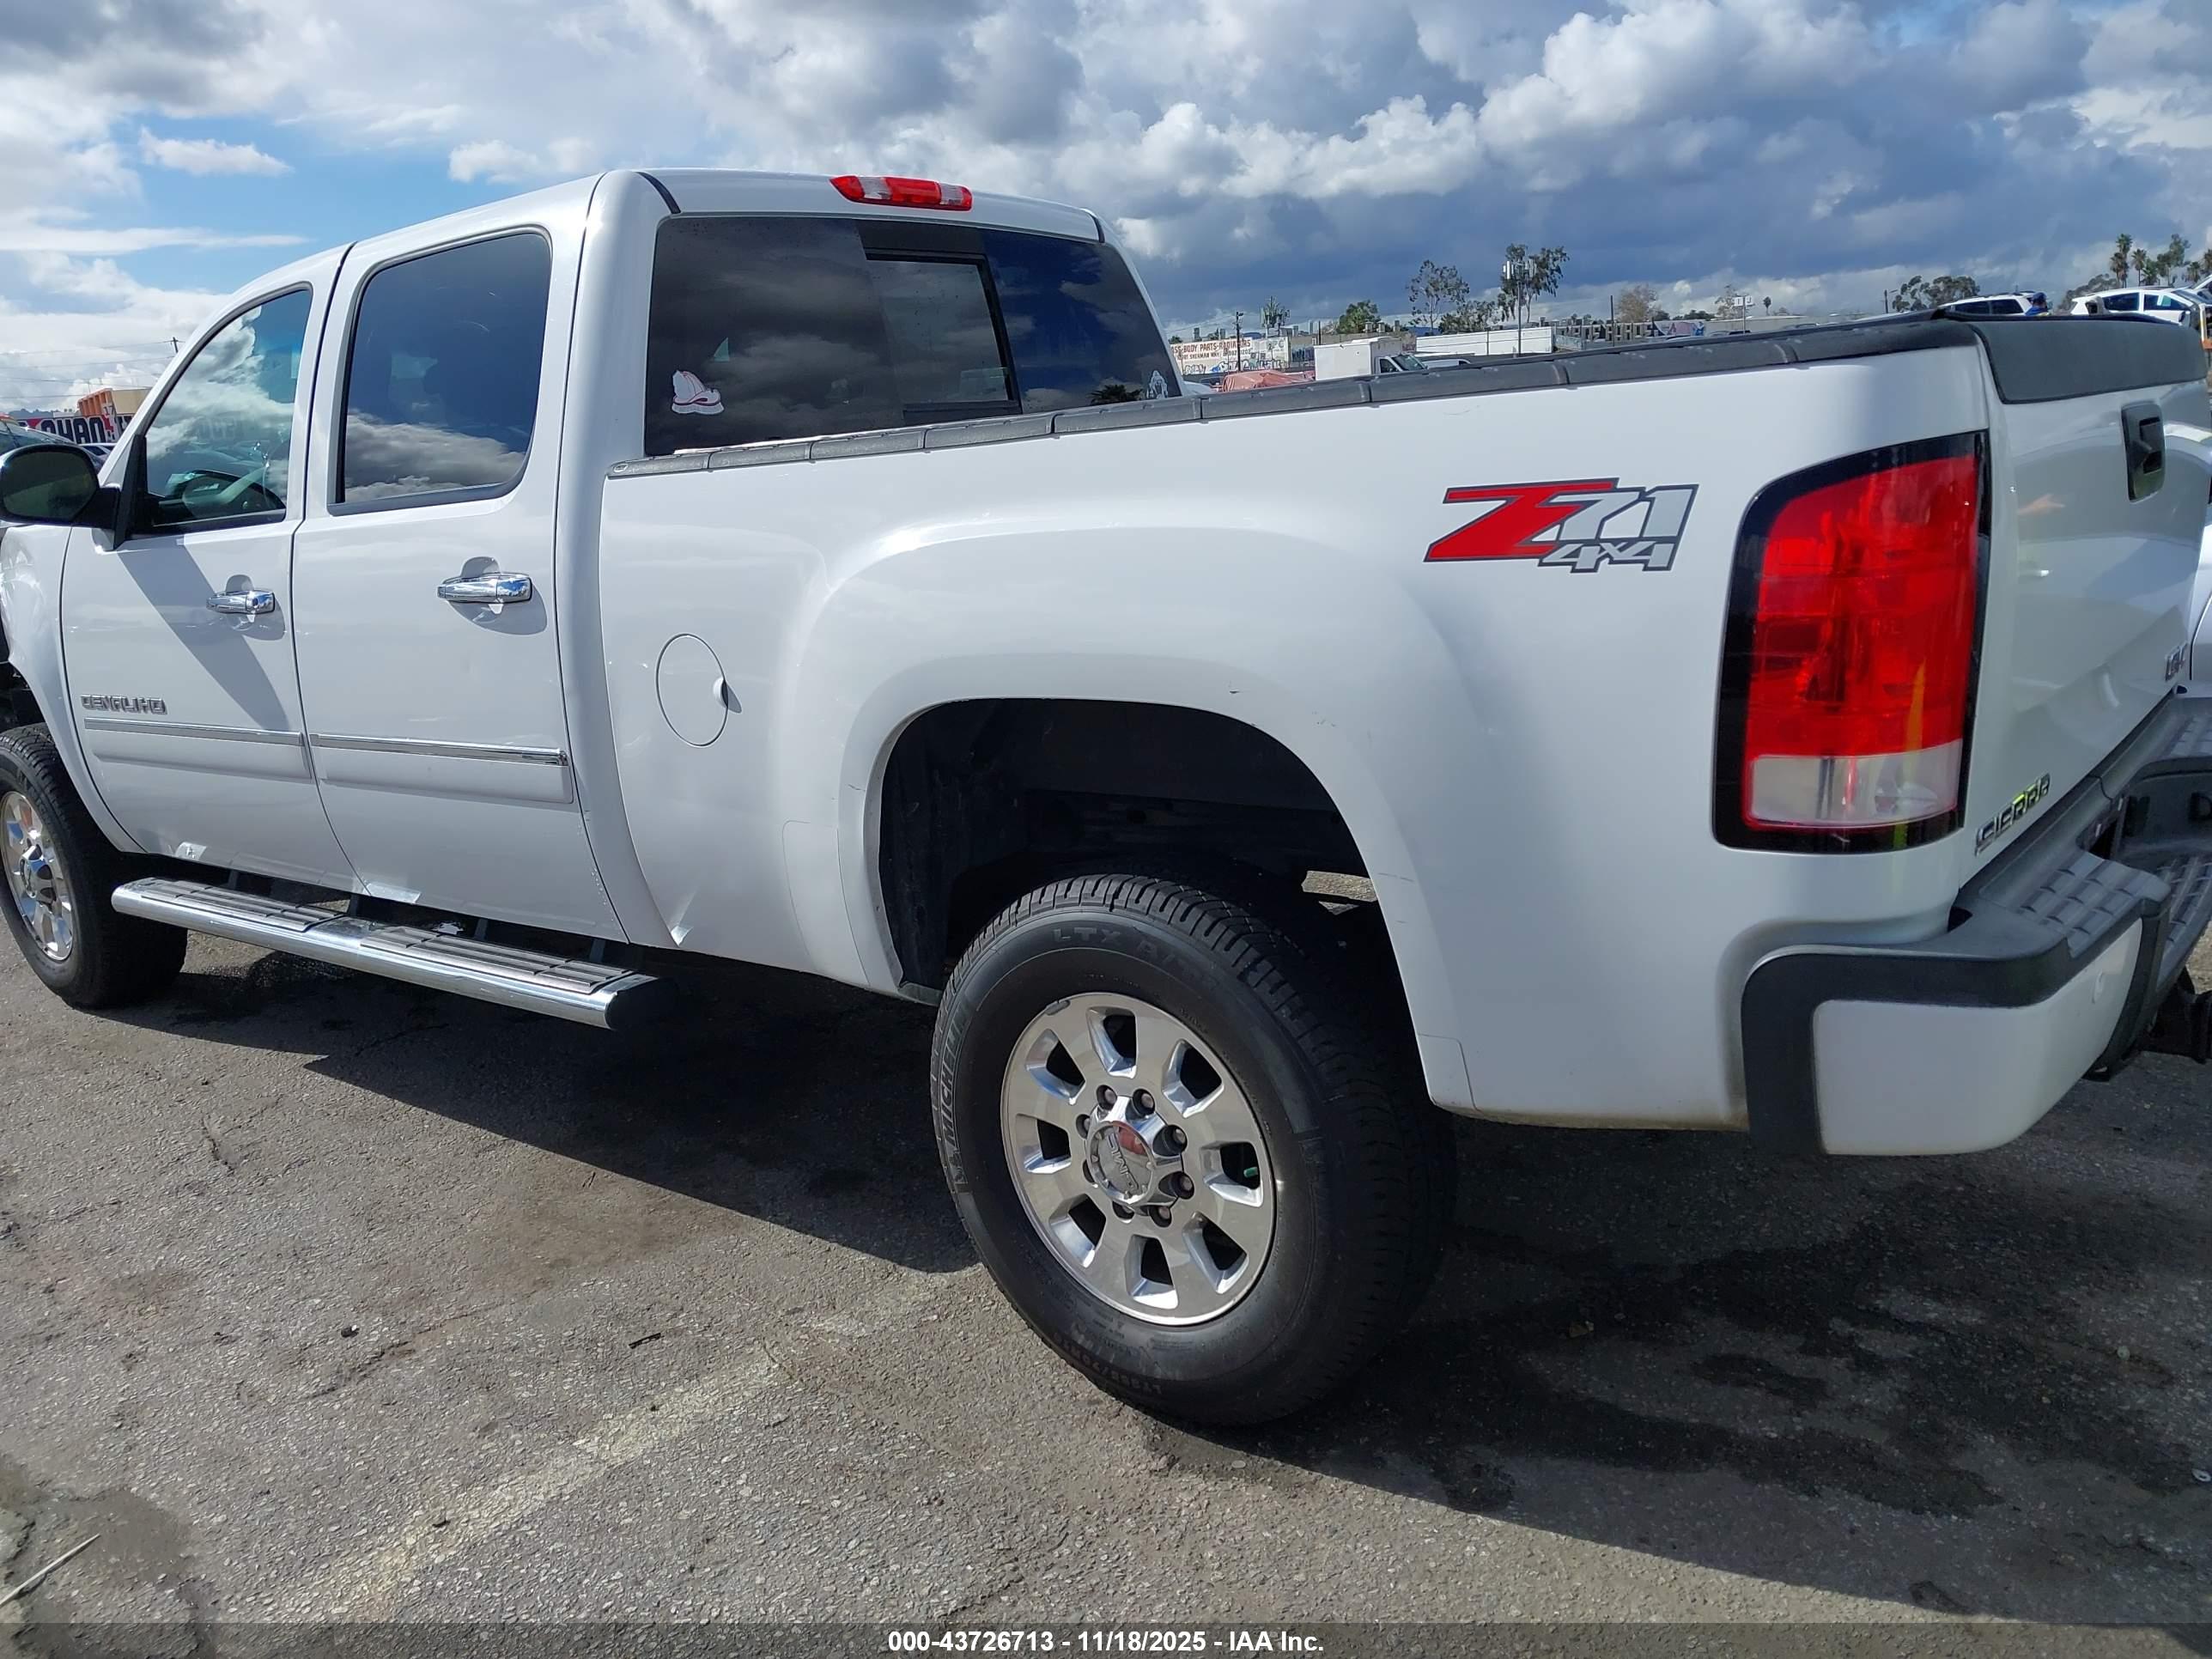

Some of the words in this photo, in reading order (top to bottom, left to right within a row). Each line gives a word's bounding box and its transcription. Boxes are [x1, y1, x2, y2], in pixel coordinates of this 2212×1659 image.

[1424, 477, 1698, 562] Z71
[81, 694, 139, 714] DENALI
[1974, 772, 2051, 857] SIERRA
[1052, 927, 1121, 945] LTX
